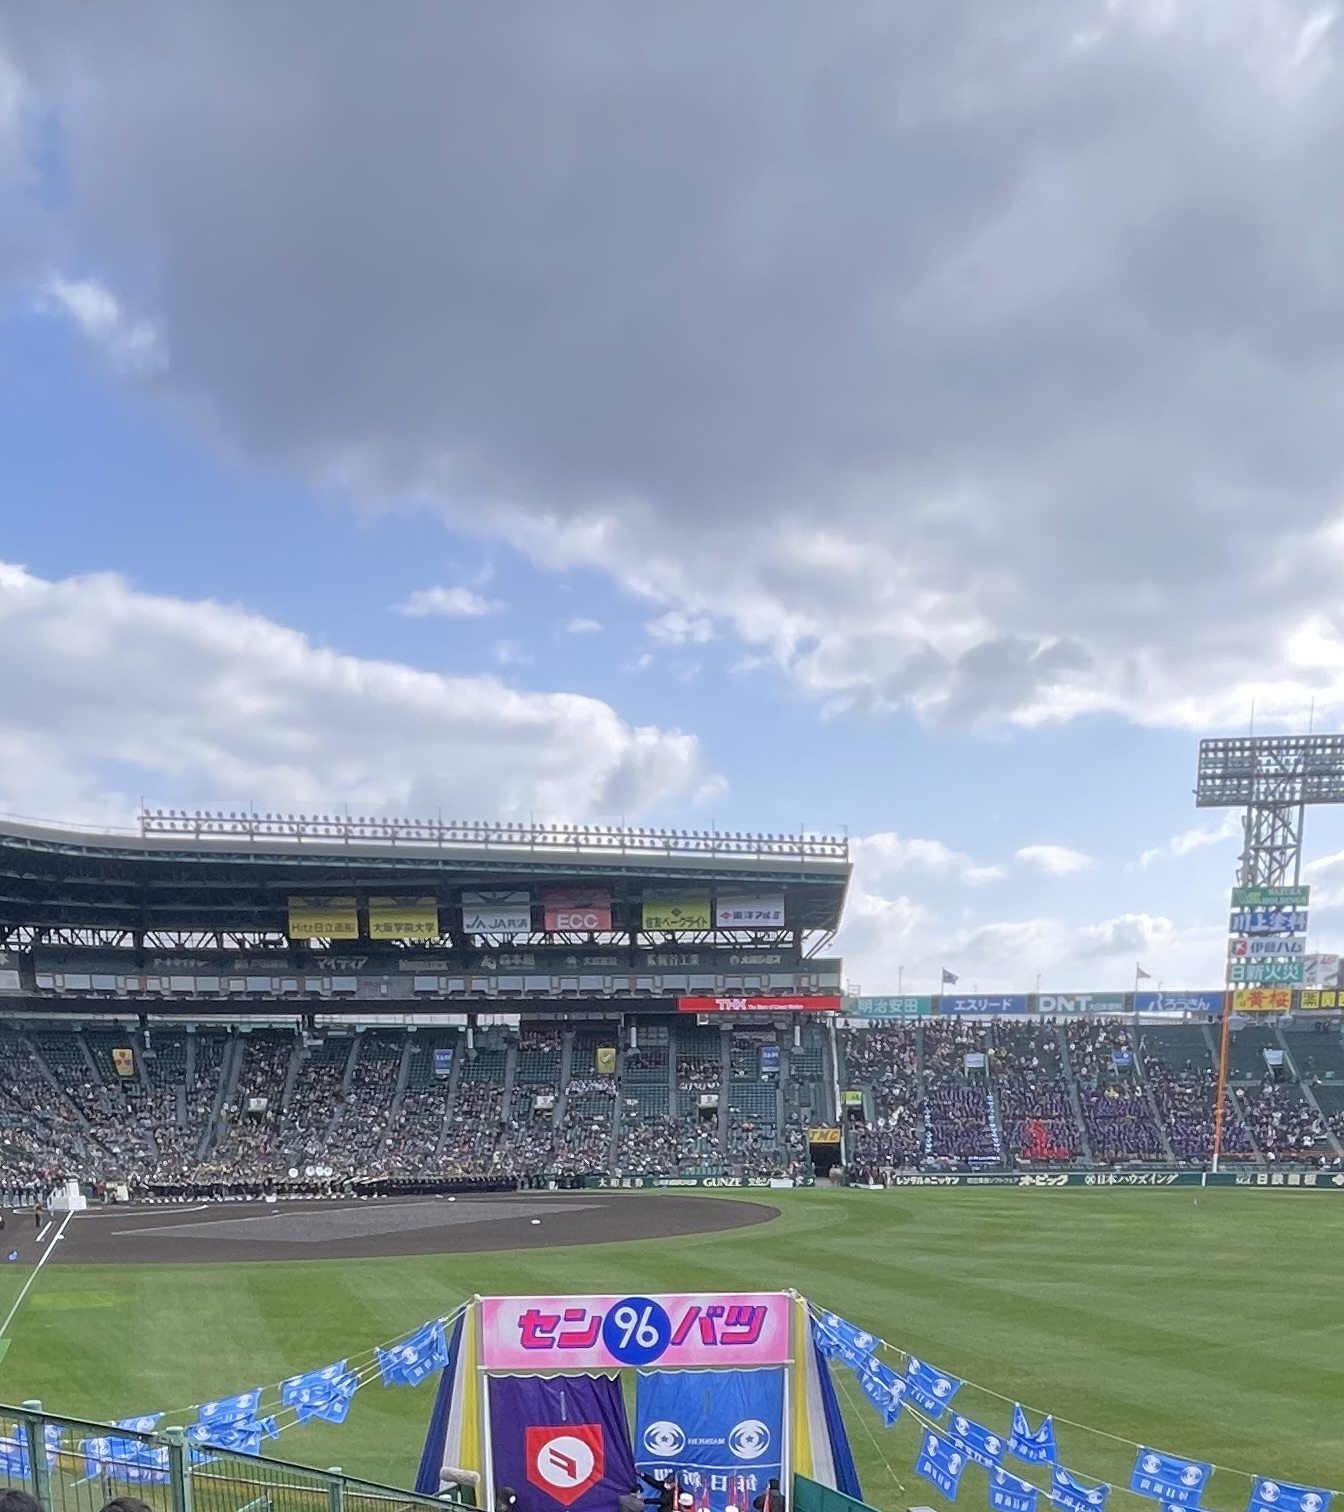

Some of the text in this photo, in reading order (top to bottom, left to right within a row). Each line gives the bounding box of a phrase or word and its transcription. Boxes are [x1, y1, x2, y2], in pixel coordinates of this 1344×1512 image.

[558, 914, 598, 929] ECC
[1232, 913, 1305, 931] 川上塗料
[1250, 941, 1303, 953] 伊藤ハム
[1231, 964, 1299, 981] 日新火災
[716, 999, 746, 1010] THK
[859, 999, 918, 1013] 明治安田
[954, 998, 1012, 1012] エスリード
[1038, 997, 1093, 1012] DNT
[1164, 998, 1211, 1011] ろうきん
[703, 1177, 742, 1188] GUNZE
[1019, 1174, 1069, 1186] オービック
[1096, 1173, 1179, 1186] 日本ハウズイング
[518, 1306, 769, 1350] セン 96 バツ
